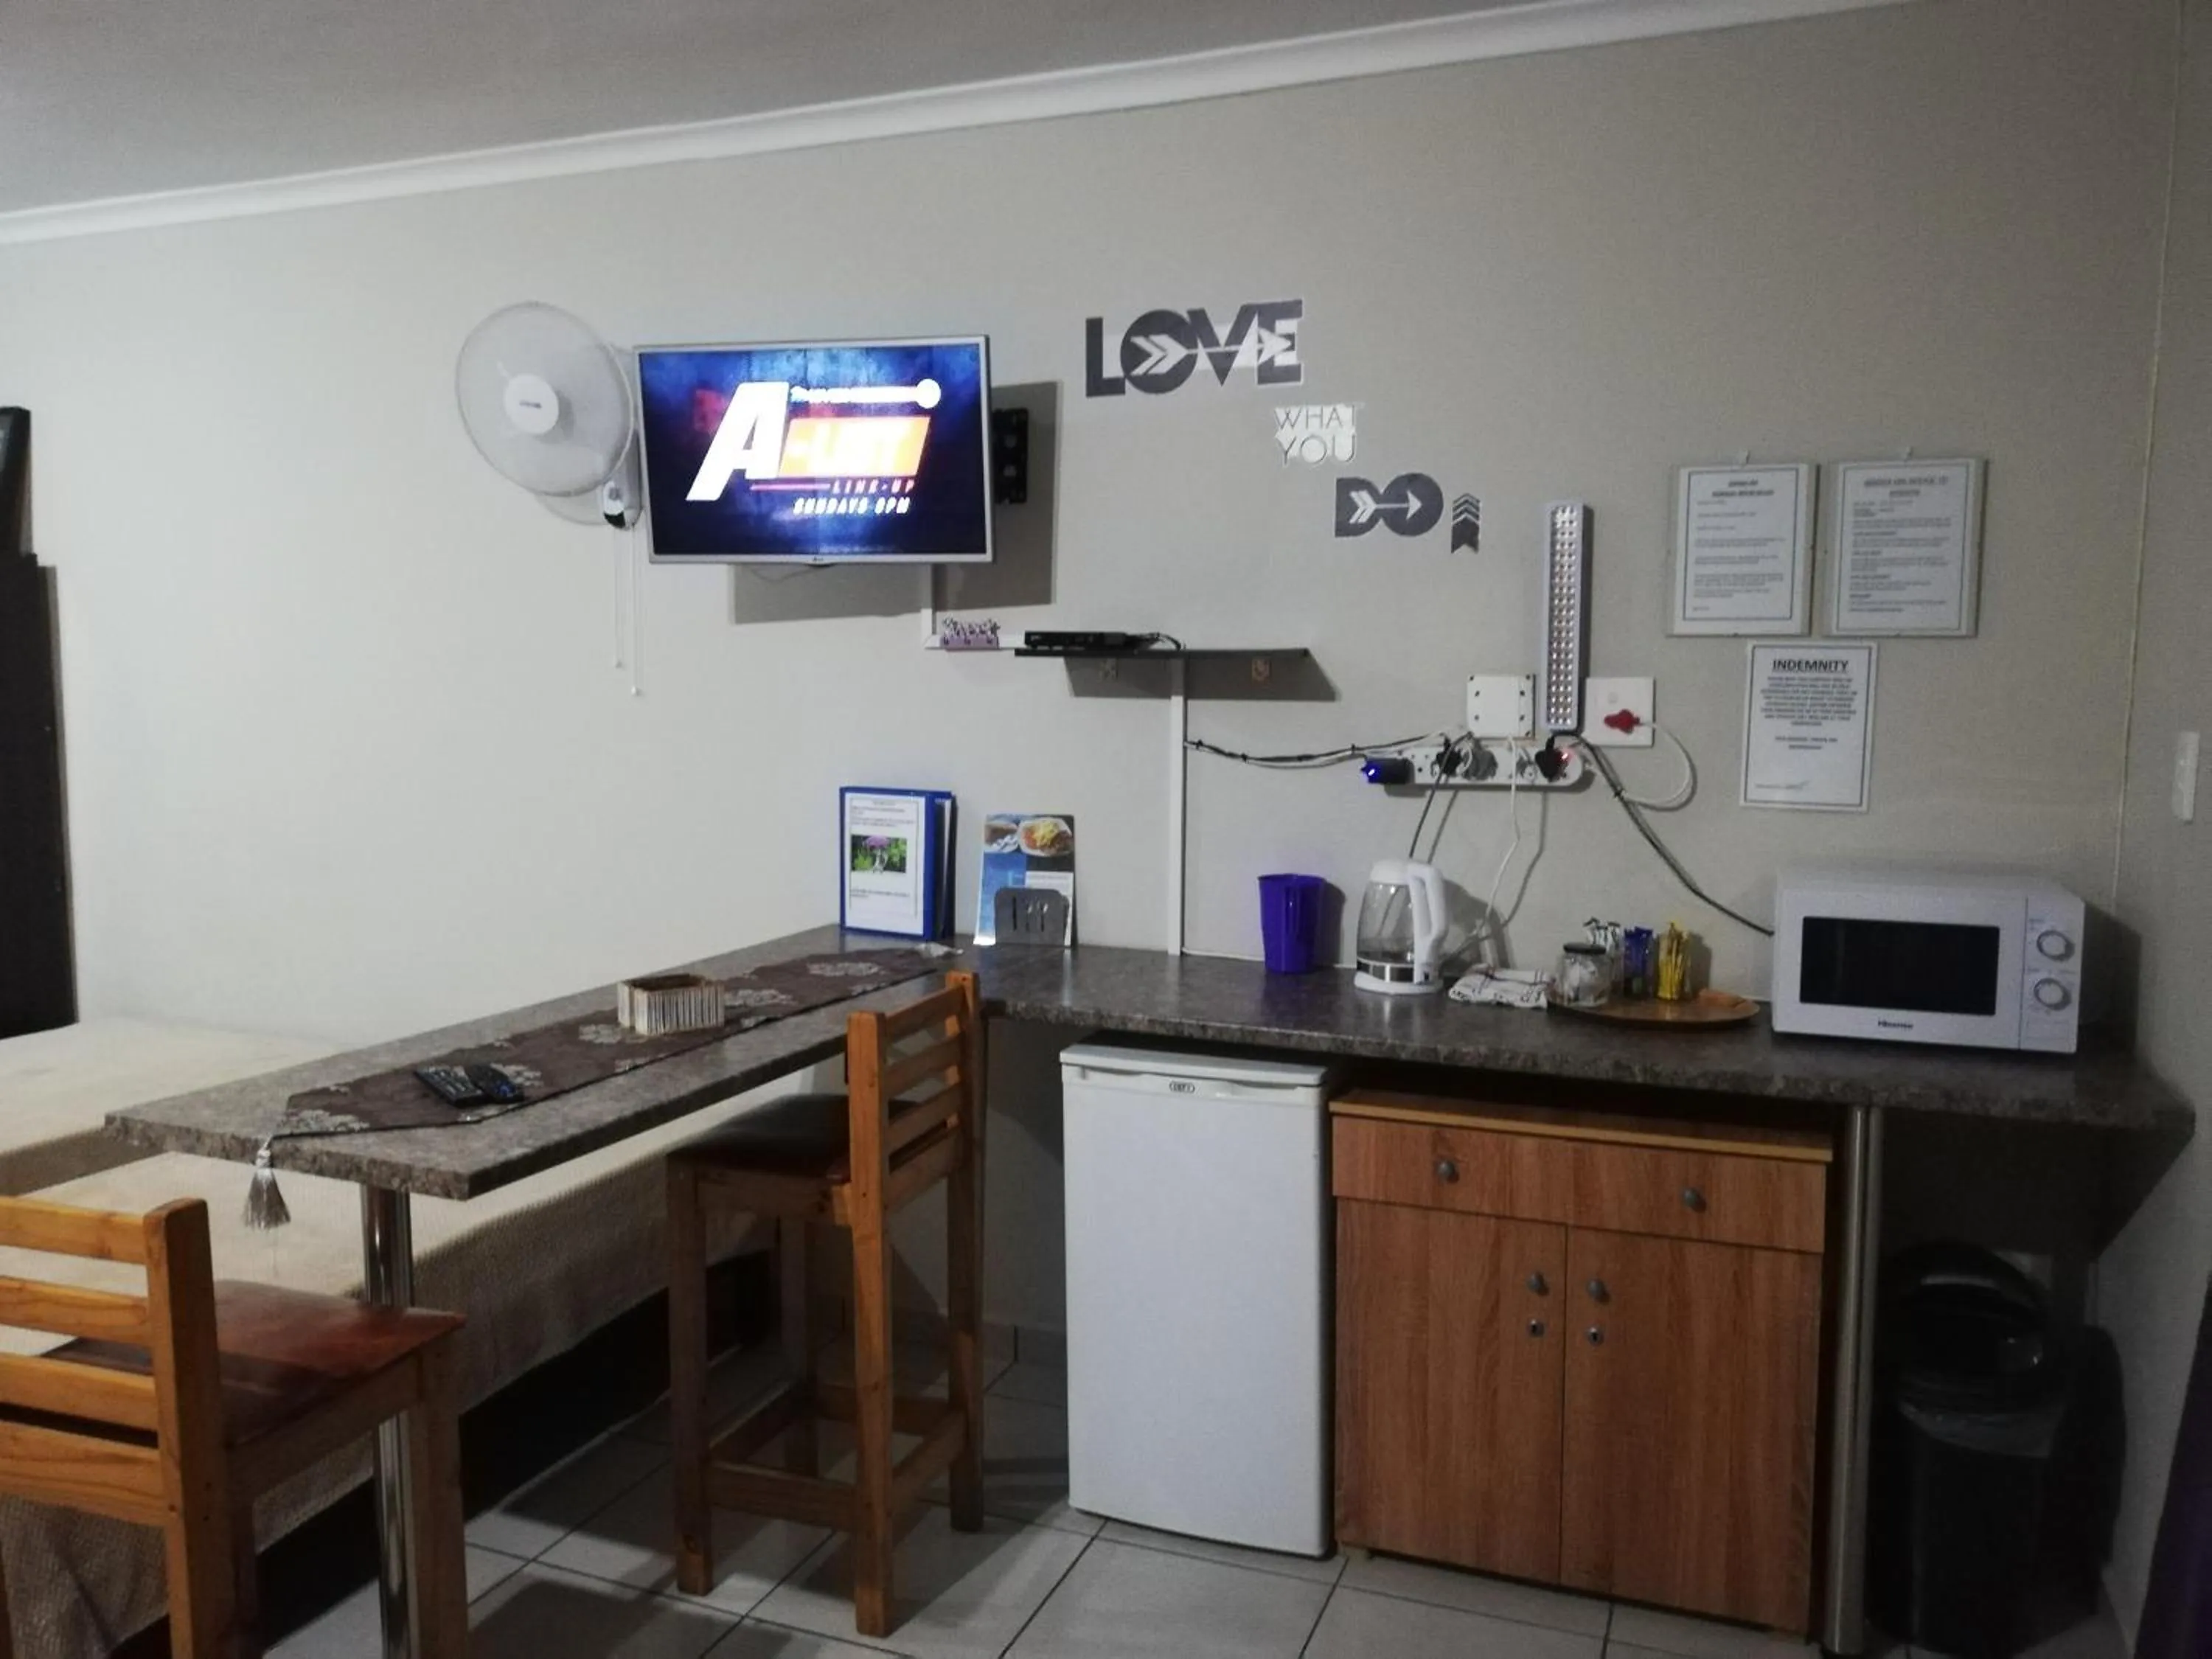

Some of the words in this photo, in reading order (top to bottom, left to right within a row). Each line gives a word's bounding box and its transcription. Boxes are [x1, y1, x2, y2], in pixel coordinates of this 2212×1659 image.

[1085, 299, 1303, 397] LOVE
[1273, 403, 1363, 430] WHAT
[1274, 434, 1357, 466] YOU
[1335, 473, 1444, 538] DO
[1773, 658, 1849, 672] INDEMNITY
